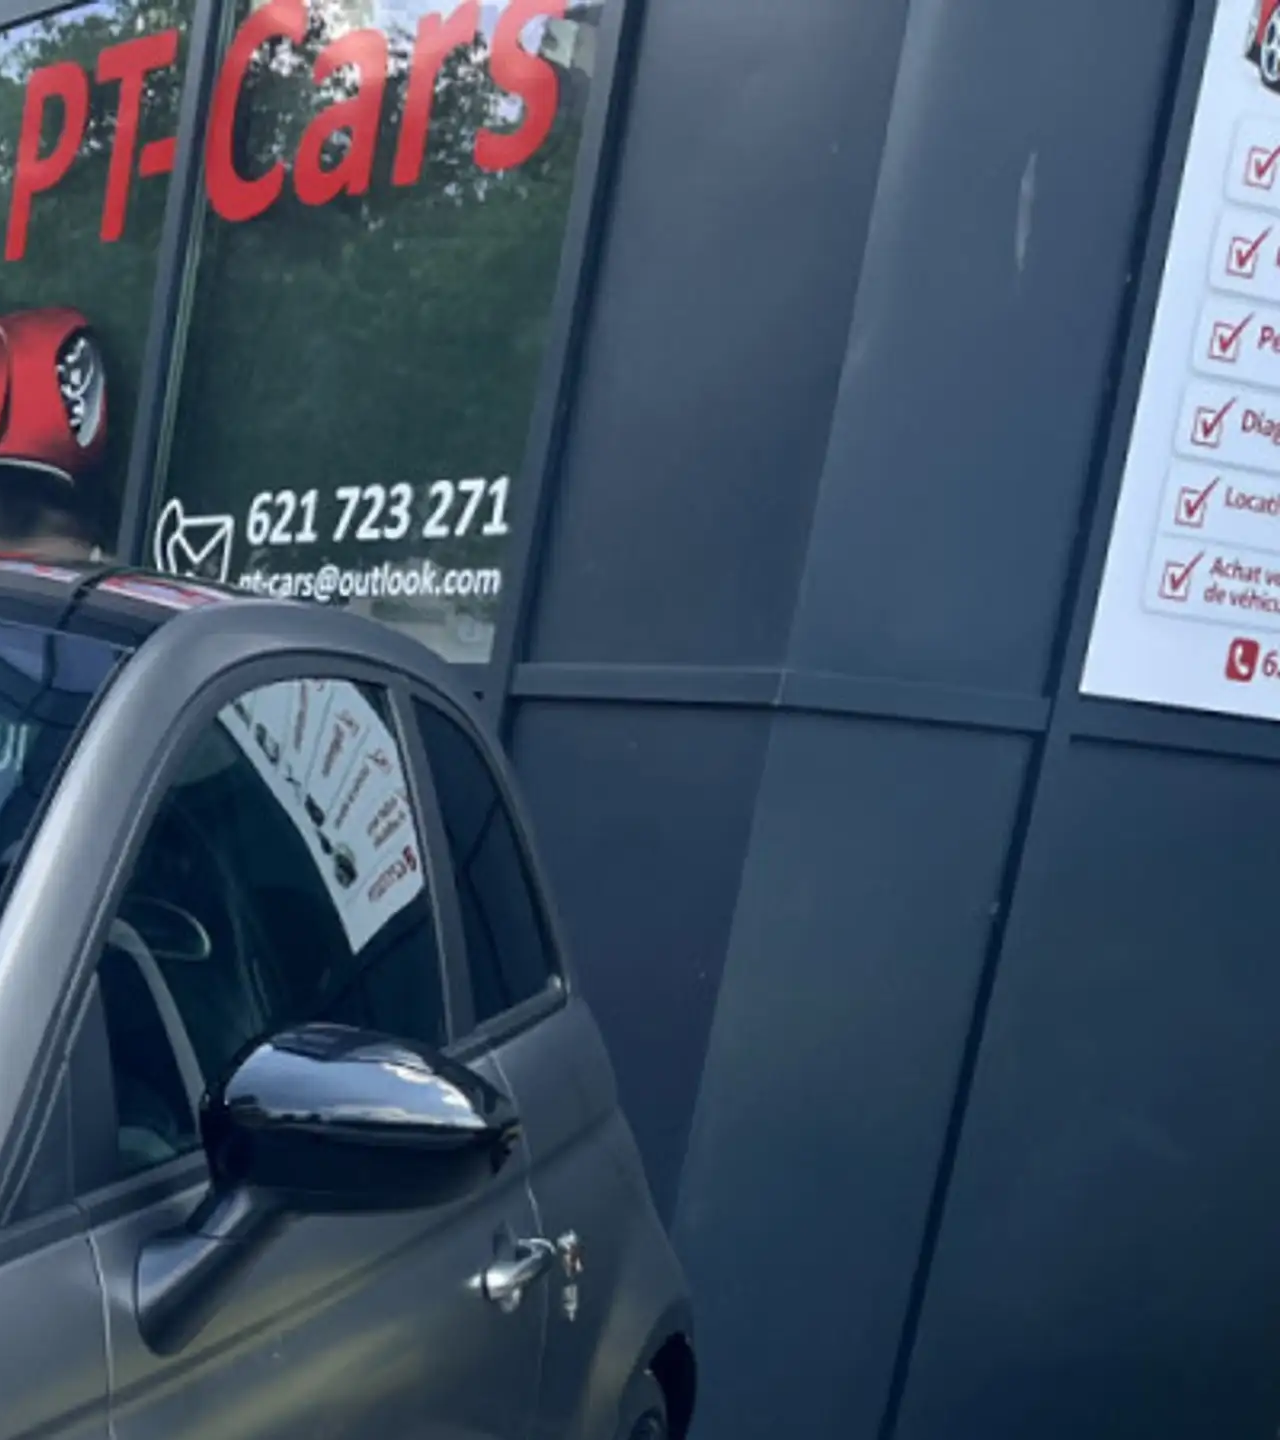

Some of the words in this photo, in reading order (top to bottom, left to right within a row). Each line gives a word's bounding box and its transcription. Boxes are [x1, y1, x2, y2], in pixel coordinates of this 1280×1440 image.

[4, 0, 568, 262] PT-Cars
[245, 488, 320, 546] 621
[331, 482, 414, 543] 723
[422, 475, 511, 539] 271
[1209, 556, 1262, 585] Achat
[1203, 581, 1226, 605] de
[1261, 650, 1280, 678] 6
